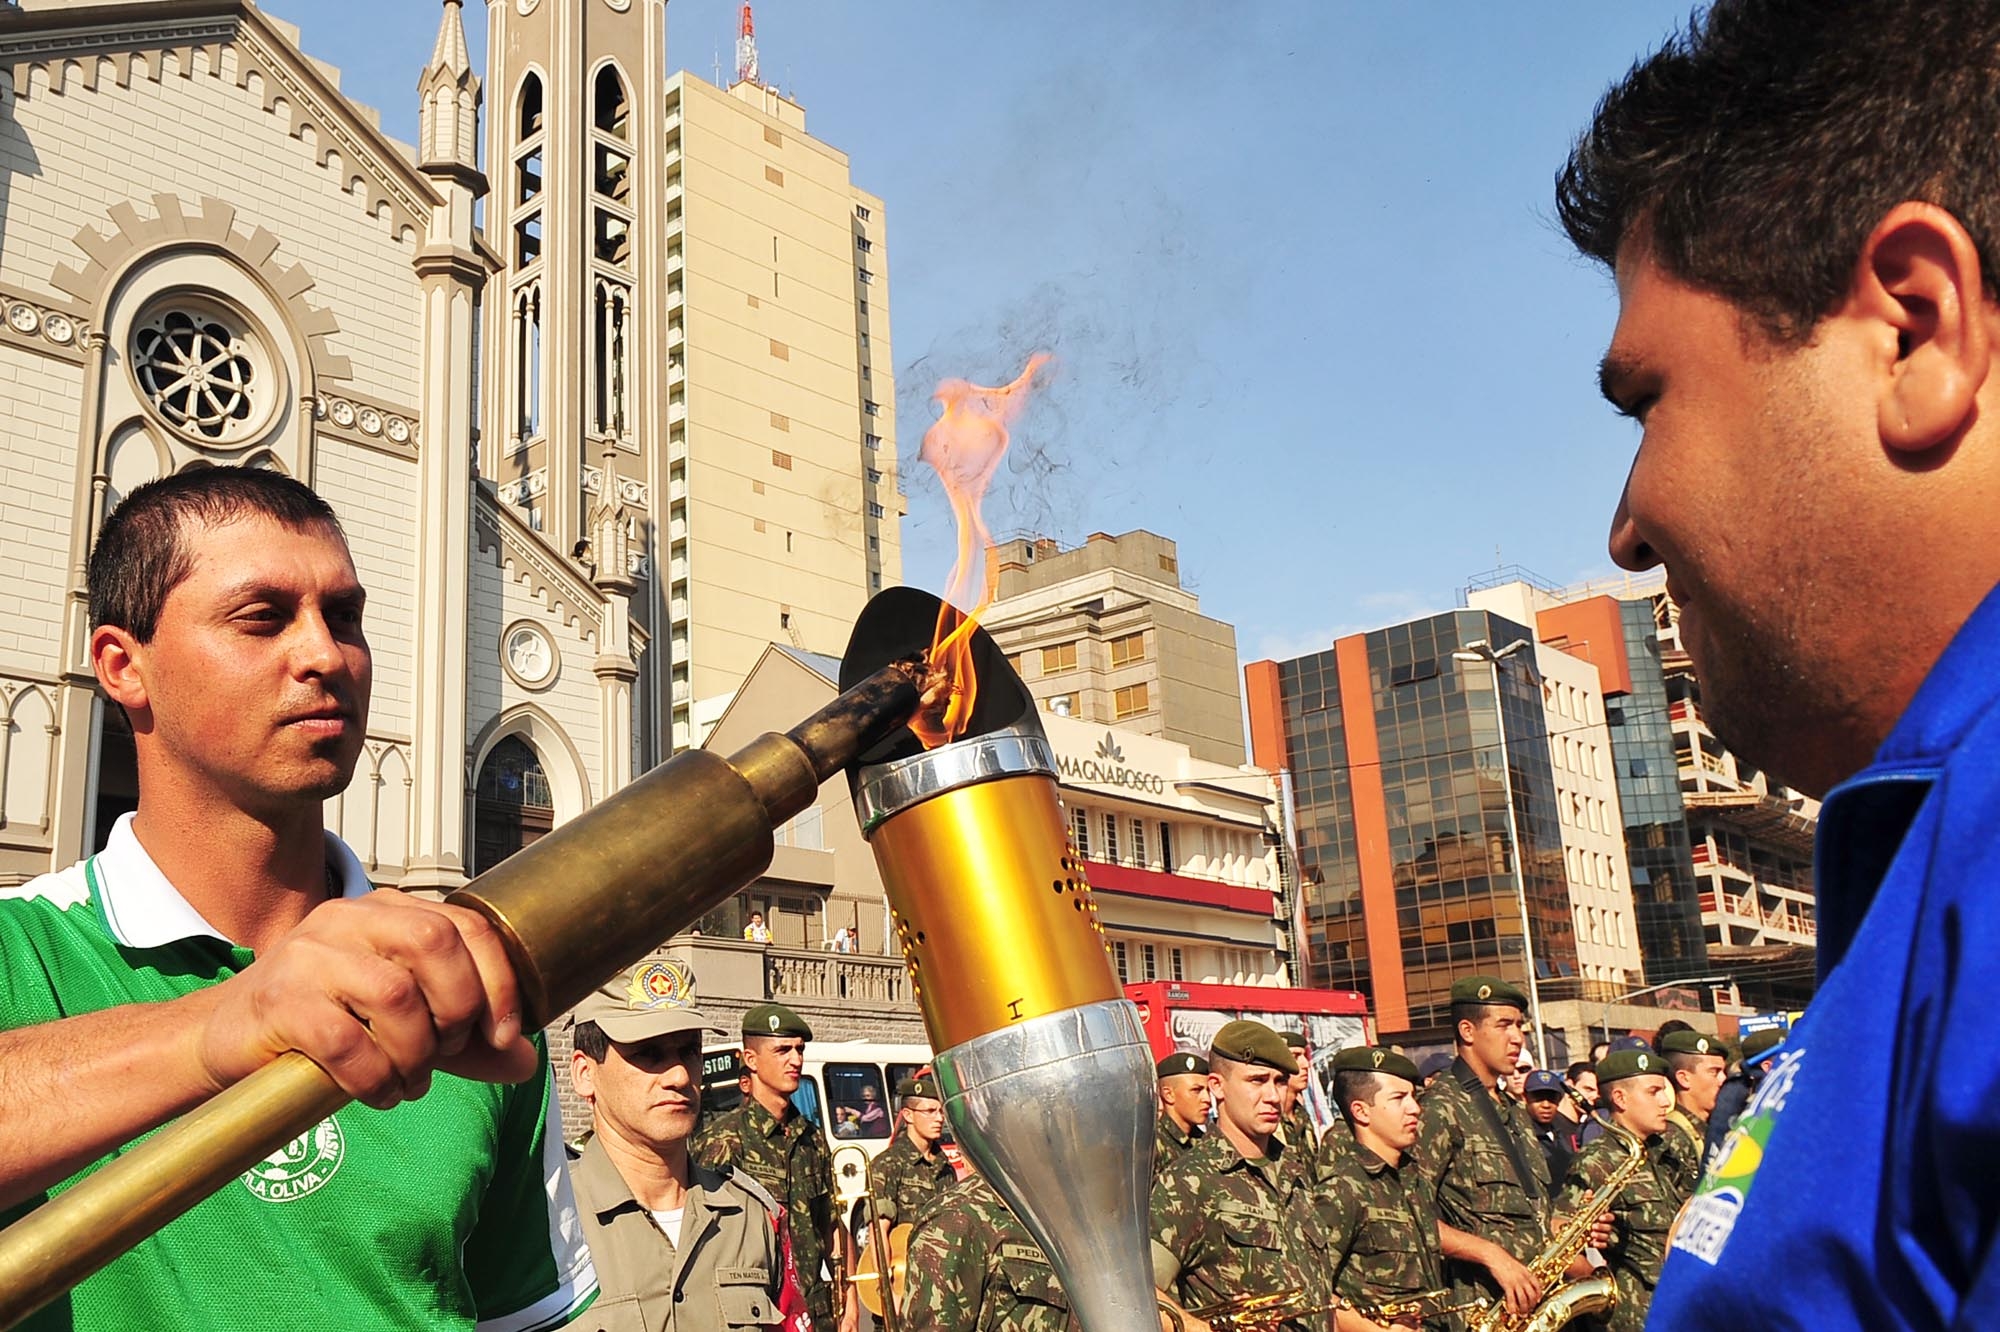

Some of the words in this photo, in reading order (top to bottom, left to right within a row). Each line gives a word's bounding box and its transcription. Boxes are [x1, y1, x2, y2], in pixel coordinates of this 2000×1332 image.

[1056, 753, 1164, 795] MAGNABOSCO
[241, 1171, 266, 1196] ILA
[269, 1172, 322, 1198] OLIVA
